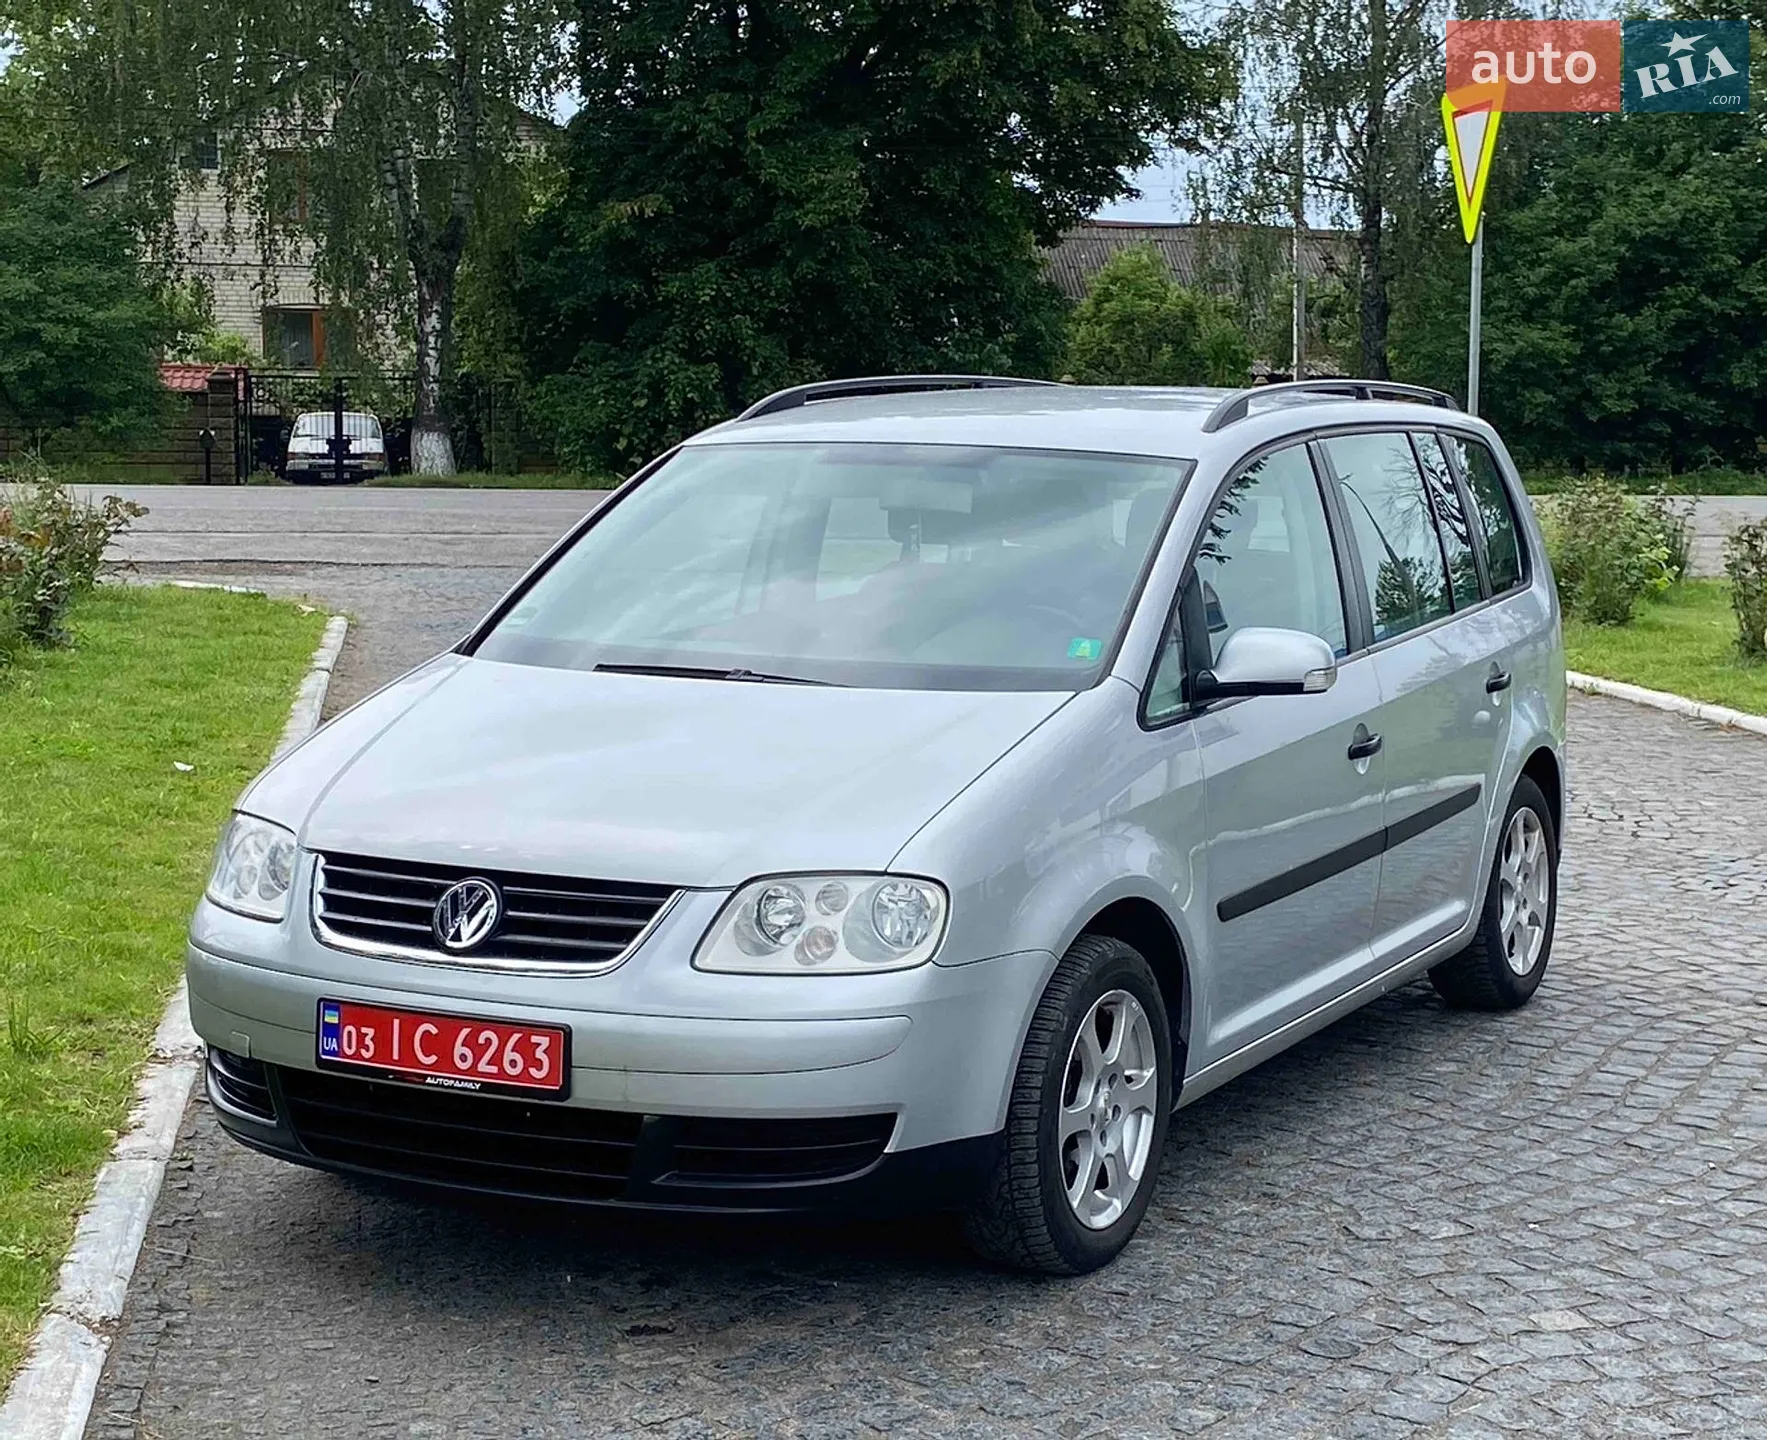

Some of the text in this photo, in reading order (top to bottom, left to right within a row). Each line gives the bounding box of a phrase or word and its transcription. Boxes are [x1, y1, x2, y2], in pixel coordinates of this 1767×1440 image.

[323, 1036, 338, 1051] UA
[342, 1025, 375, 1059] 03
[453, 1028, 550, 1079] 6263
[425, 1077, 481, 1090] AUTOFAMILY
